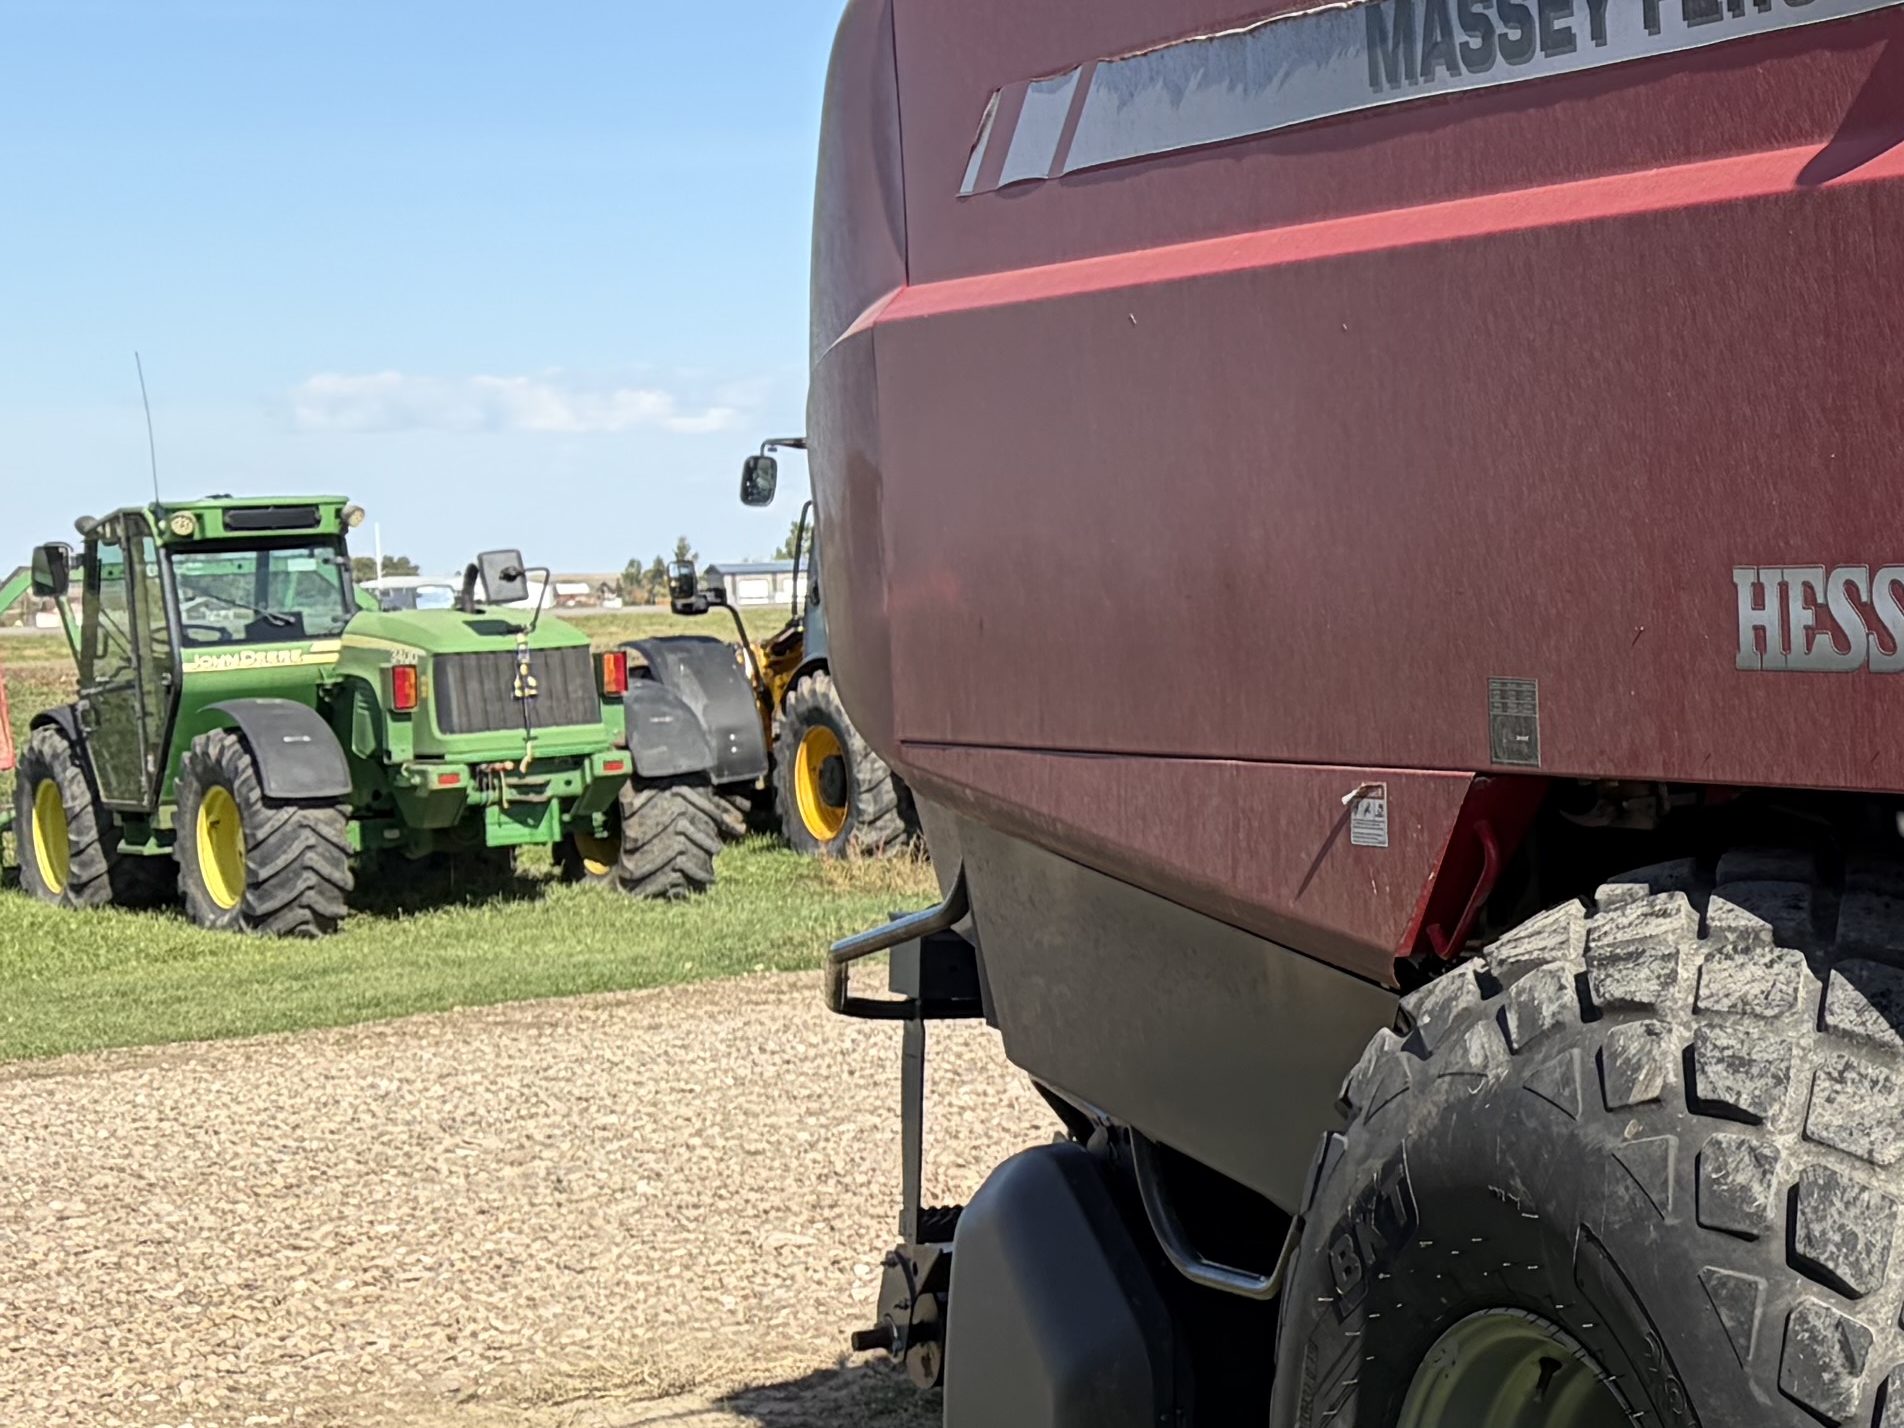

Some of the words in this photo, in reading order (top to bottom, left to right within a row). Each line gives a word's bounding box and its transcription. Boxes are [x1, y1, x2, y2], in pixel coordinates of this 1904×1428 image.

[194, 653, 239, 670] JOHN
[240, 649, 302, 666] DEERE
[1330, 1161, 1410, 1296] BKT
